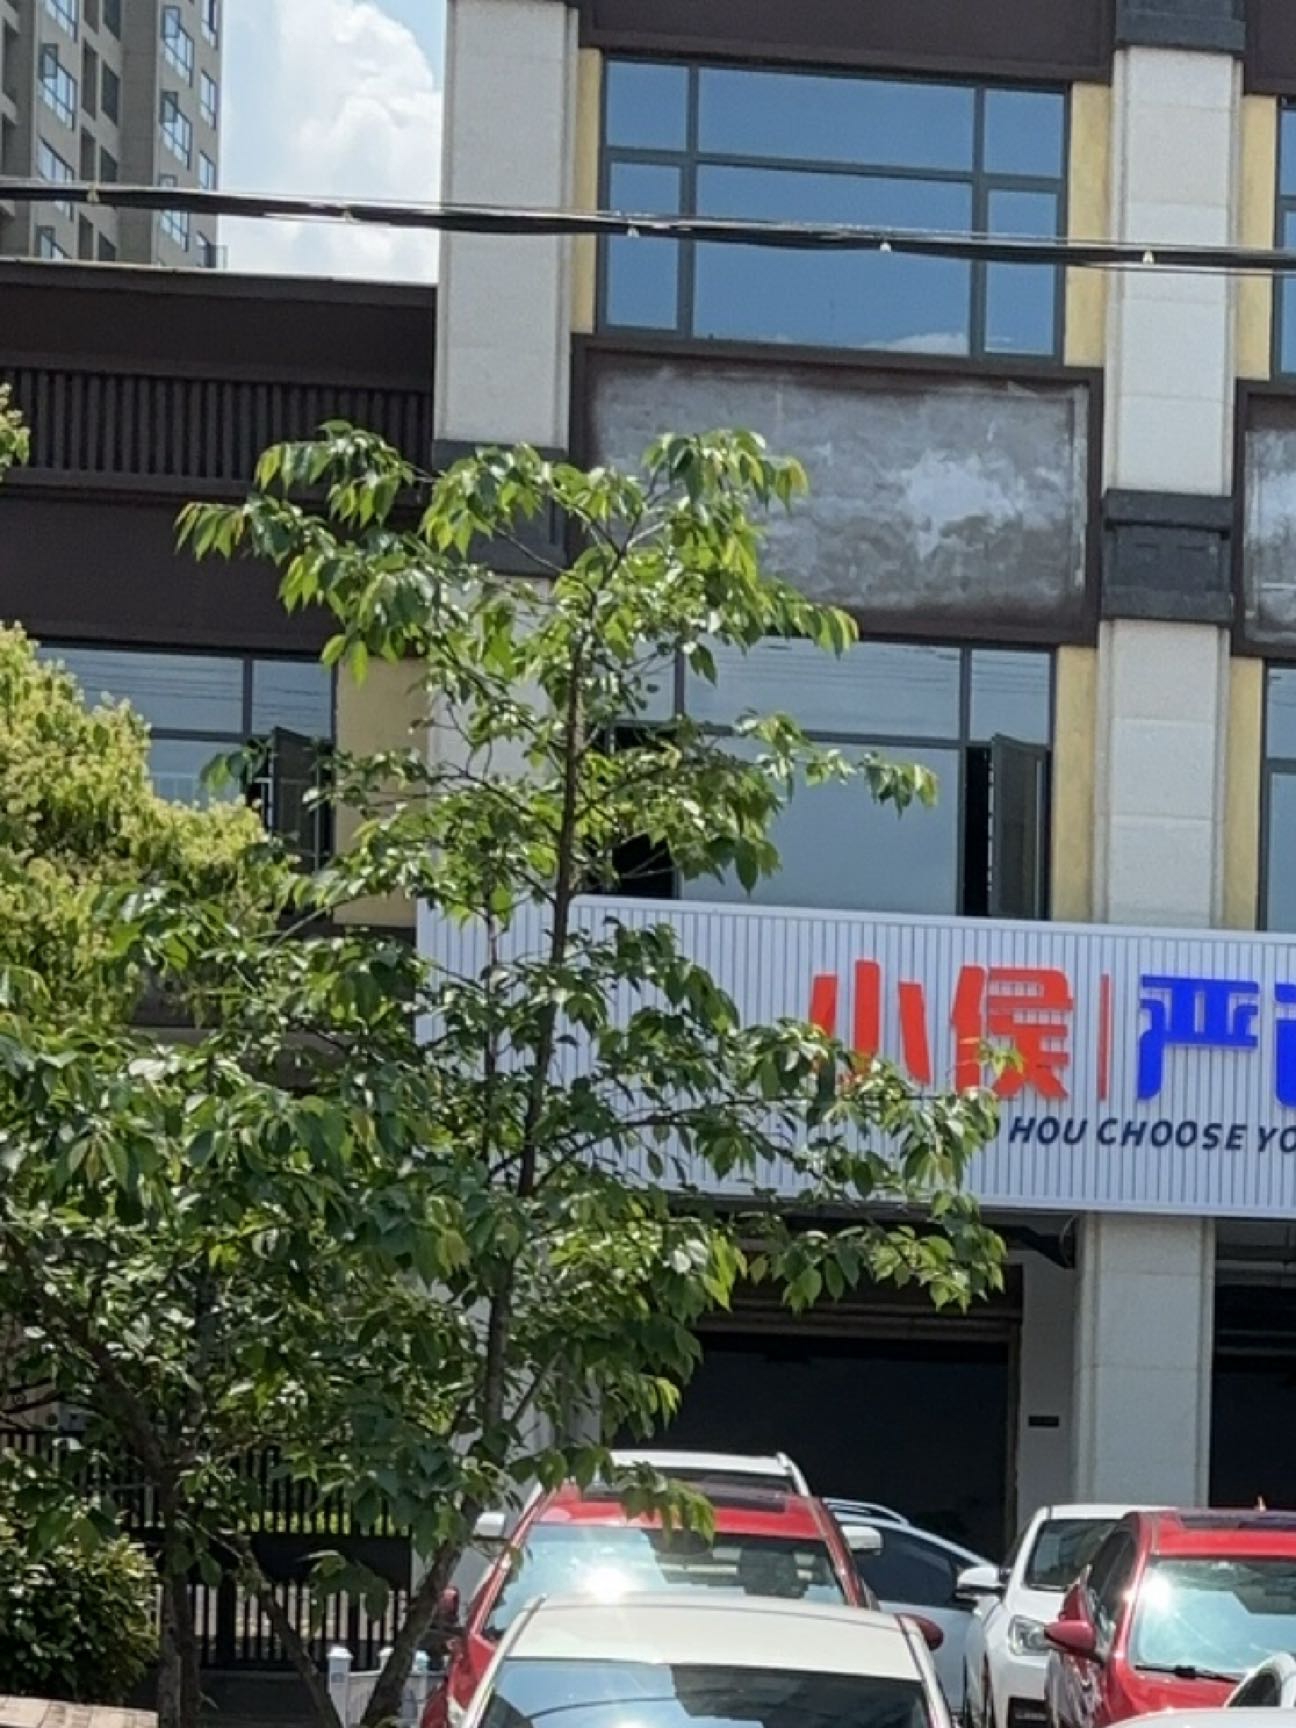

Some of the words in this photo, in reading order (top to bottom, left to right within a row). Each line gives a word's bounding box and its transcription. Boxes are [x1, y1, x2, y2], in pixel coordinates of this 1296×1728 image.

[808, 959, 1073, 1101] 小侯
[1008, 1115, 1088, 1146] HOU
[1096, 1117, 1248, 1152] CHOOSE
